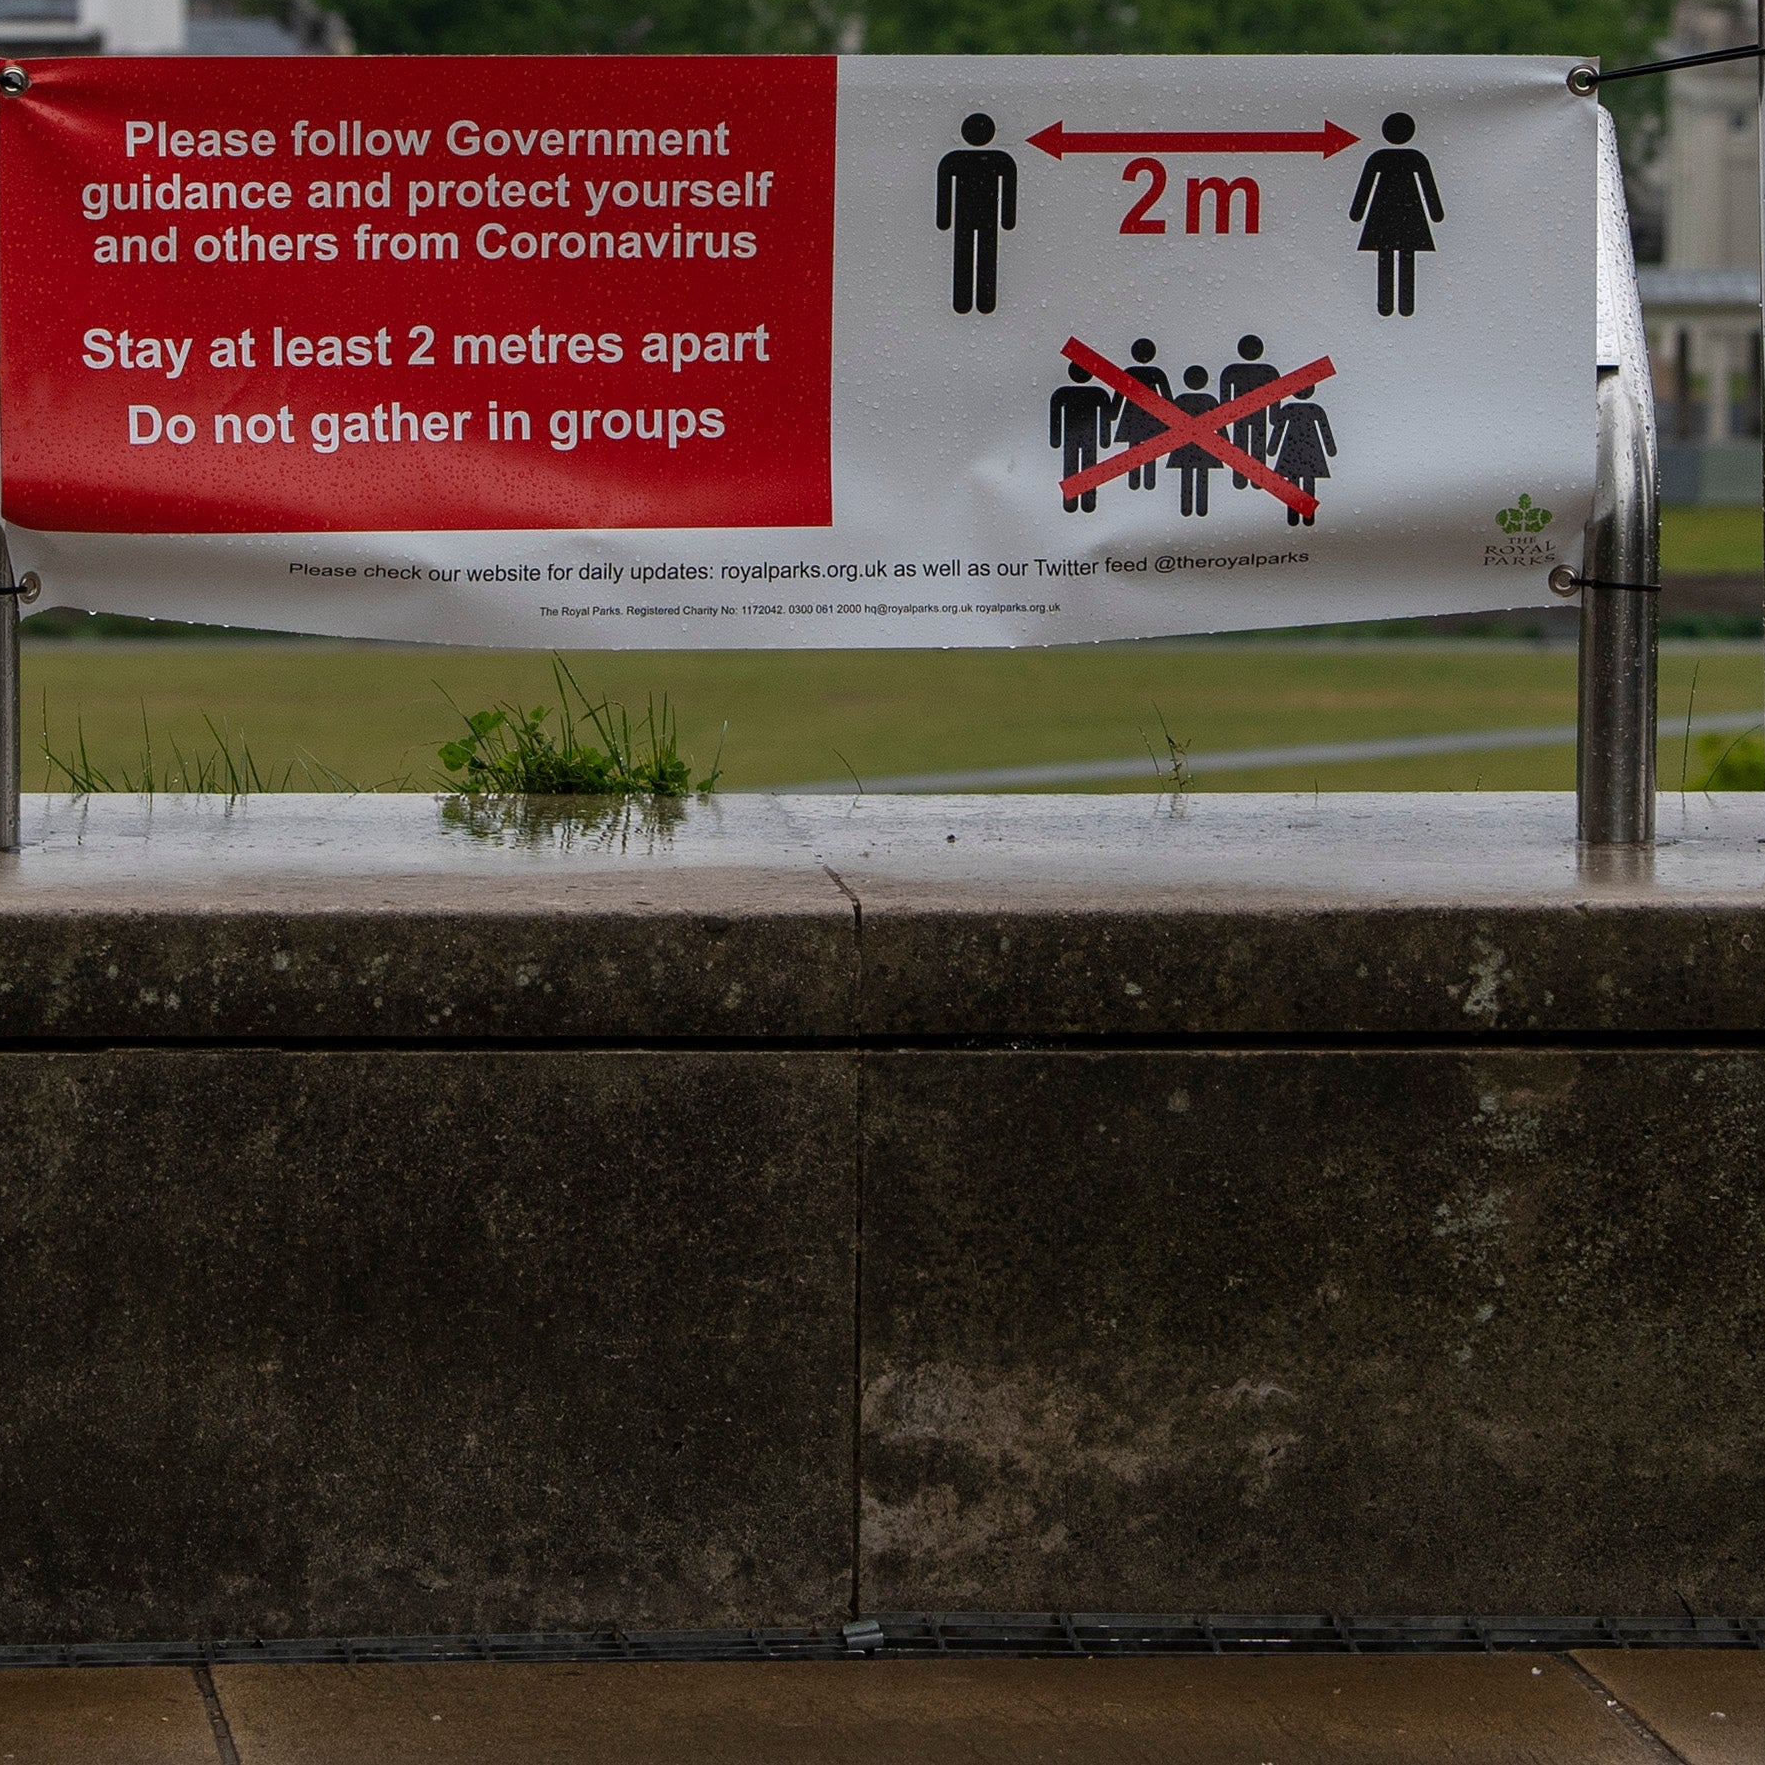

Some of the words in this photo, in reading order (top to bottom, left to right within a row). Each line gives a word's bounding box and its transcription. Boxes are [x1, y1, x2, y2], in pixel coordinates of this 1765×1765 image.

[125, 120, 276, 158] Please
[290, 120, 432, 157] follow
[446, 119, 730, 156] Government
[82, 173, 292, 220] guidance
[307, 171, 391, 209] and
[408, 172, 570, 217] protect
[584, 170, 774, 217] yourself
[93, 225, 177, 264] and
[194, 225, 339, 263] others
[353, 223, 459, 260] from
[476, 222, 757, 260] Coronavirus
[82, 327, 193, 379] Stay
[209, 328, 256, 368] at
[273, 326, 393, 367] least
[407, 325, 435, 365] 2
[453, 324, 624, 365] metres
[641, 323, 770, 373] apart
[128, 404, 196, 445] Do
[214, 404, 296, 444] not
[310, 401, 473, 454] gather
[488, 400, 531, 441] in
[549, 408, 725, 451] groups
[1485, 539, 1557, 556] ROYAL
[1508, 537, 1537, 545] THE
[289, 562, 357, 578] Please
[363, 564, 422, 580] check
[428, 568, 461, 582] our
[466, 563, 541, 583] website
[546, 562, 574, 582] for
[578, 562, 624, 585] daily
[630, 562, 714, 585] updates:
[720, 559, 888, 584] royalparks.org.uk
[893, 563, 917, 578] as
[922, 558, 962, 578] well
[967, 562, 991, 577] as
[996, 562, 1029, 577] our
[1033, 558, 1100, 577] Twitter
[1104, 556, 1148, 574] feed
[1154, 551, 1310, 574] @theroyalparks
[1483, 553, 1556, 567] PARKS
[539, 606, 559, 617] The
[561, 606, 590, 619] Royal
[592, 605, 624, 616] Parks.
[626, 605, 681, 618] Registered
[682, 605, 719, 618] Charity
[720, 605, 739, 616] No:
[741, 604, 786, 616] 1172042.
[788, 604, 814, 615] 0300
[815, 603, 834, 615] 061
[836, 603, 862, 614] 2000
[864, 602, 974, 617] hq@royalparks.org.uk
[975, 602, 1062, 616] royalparks.org.uk
